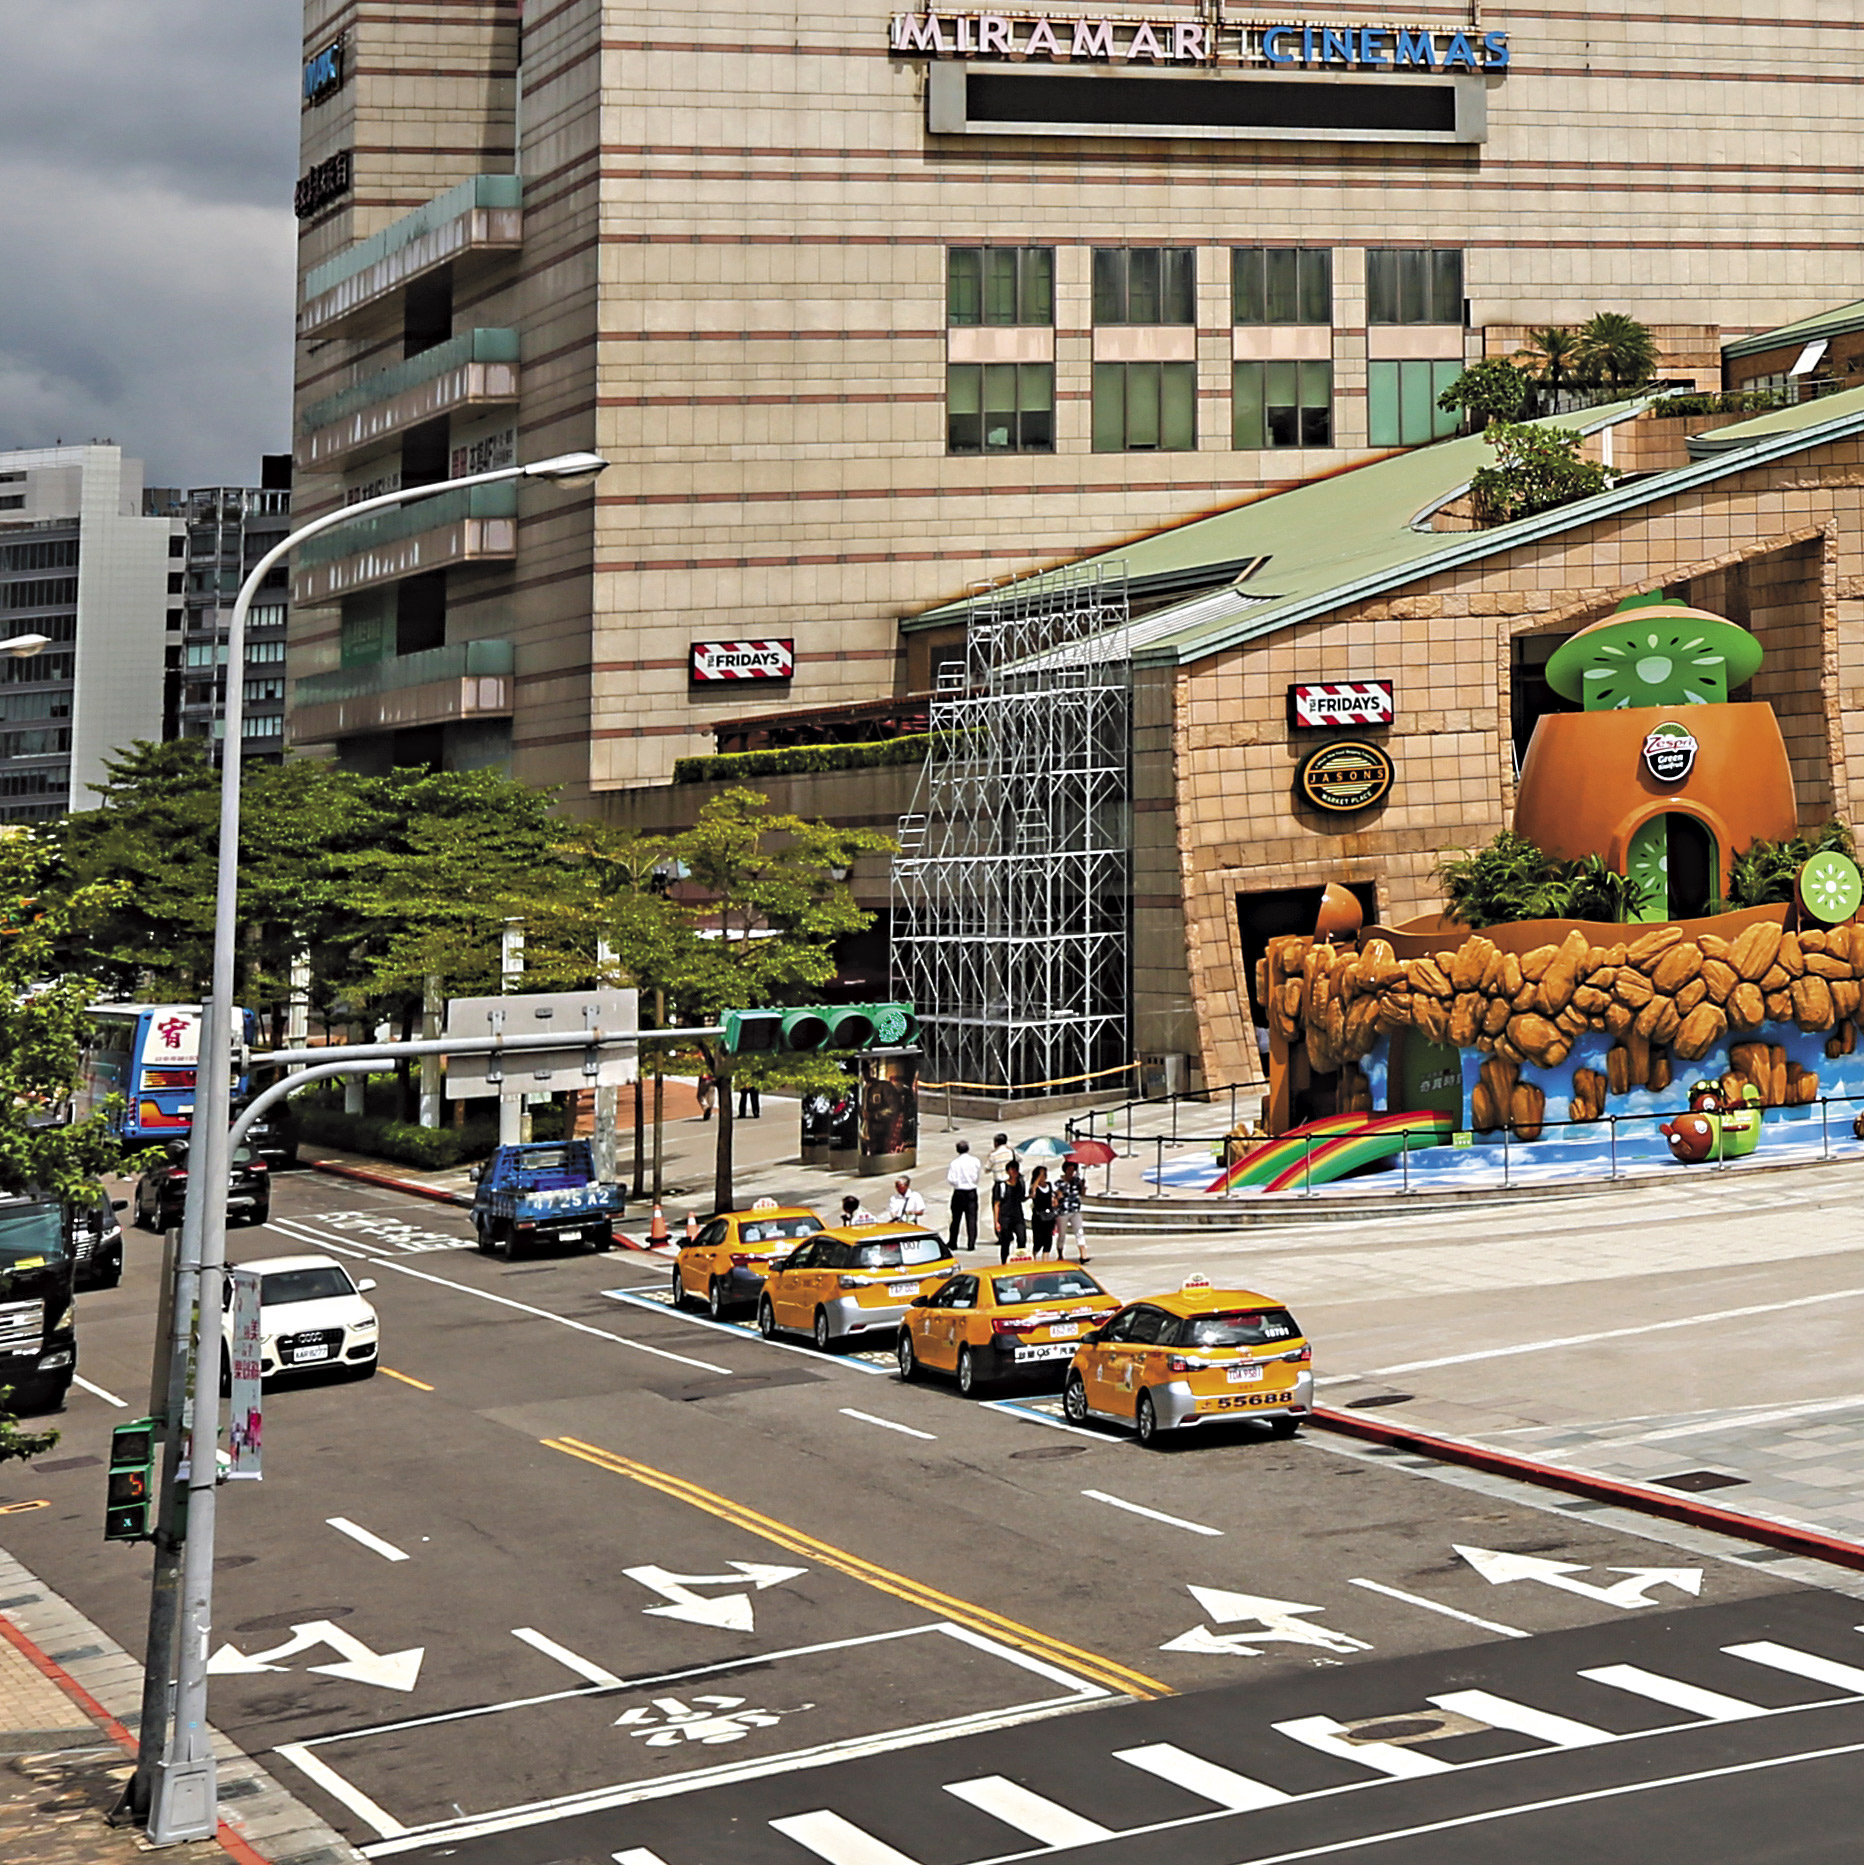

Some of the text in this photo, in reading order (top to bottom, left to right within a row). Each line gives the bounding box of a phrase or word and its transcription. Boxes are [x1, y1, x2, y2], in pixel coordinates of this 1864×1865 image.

[898, 13, 1511, 67] MIRAMAR CINEMAS
[716, 653, 779, 667] FRIDAYS
[1317, 696, 1380, 712] FRIDAYS
[1310, 769, 1384, 783] JASONS
[1321, 790, 1373, 805] MARKET PLACE
[1217, 1392, 1292, 1409] 55688
[129, 1471, 143, 1496] 5
